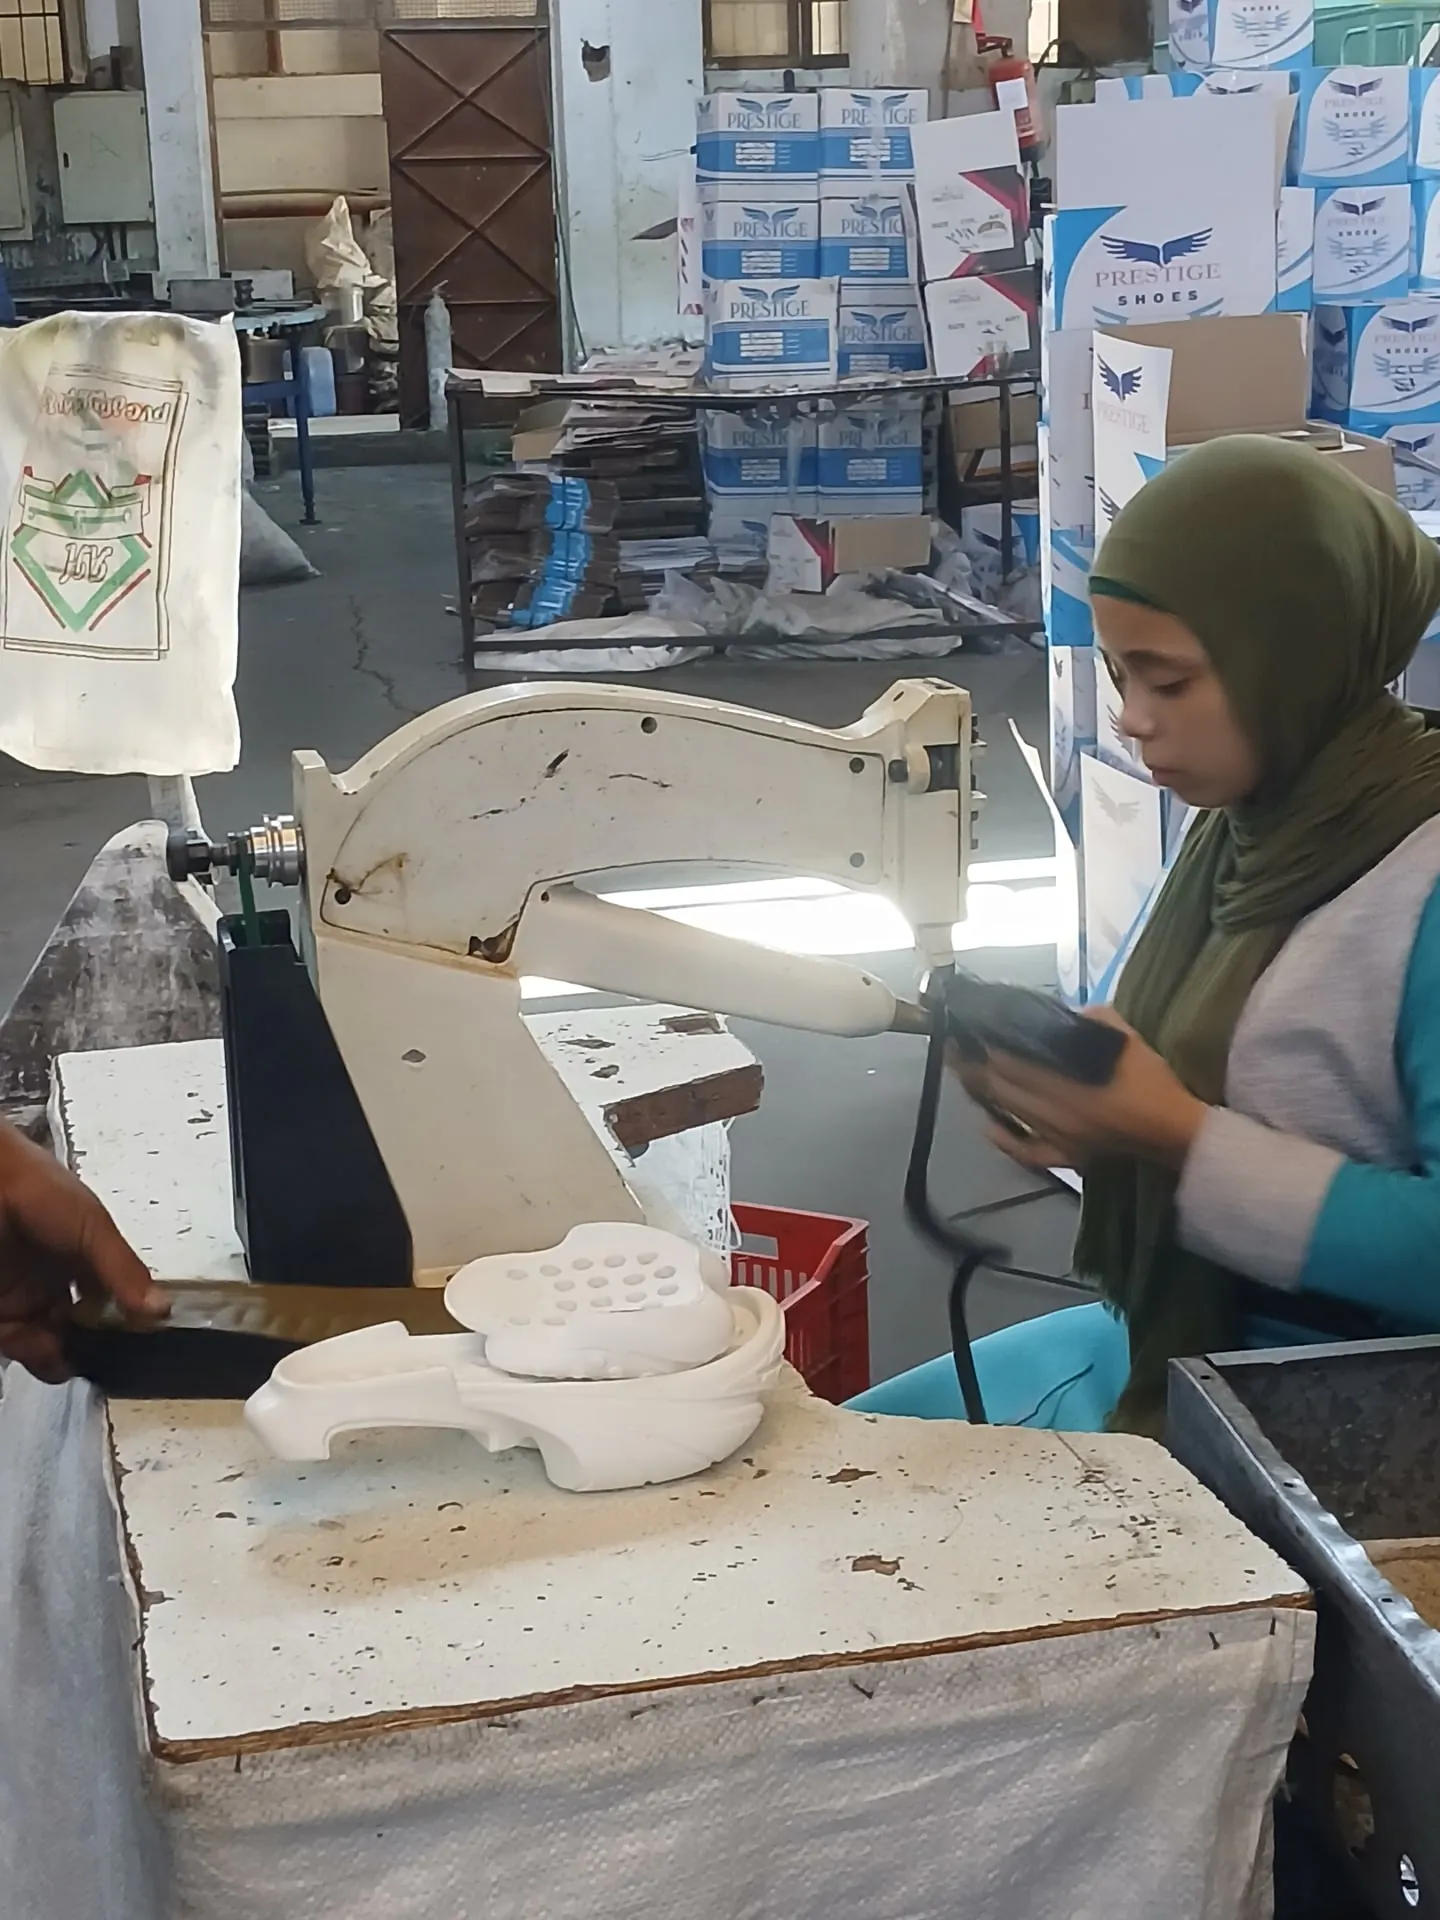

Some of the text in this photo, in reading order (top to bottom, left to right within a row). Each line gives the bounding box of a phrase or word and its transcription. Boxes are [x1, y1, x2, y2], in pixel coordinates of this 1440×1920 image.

[727, 112, 801, 129] PRESTIGE
[733, 221, 808, 239] PRESTIGE
[1095, 263, 1221, 287] PRESTIGE
[1118, 290, 1198, 306] SHOES
[730, 300, 812, 319] PRESTIGE
[842, 325, 916, 342] PRESTIGE
